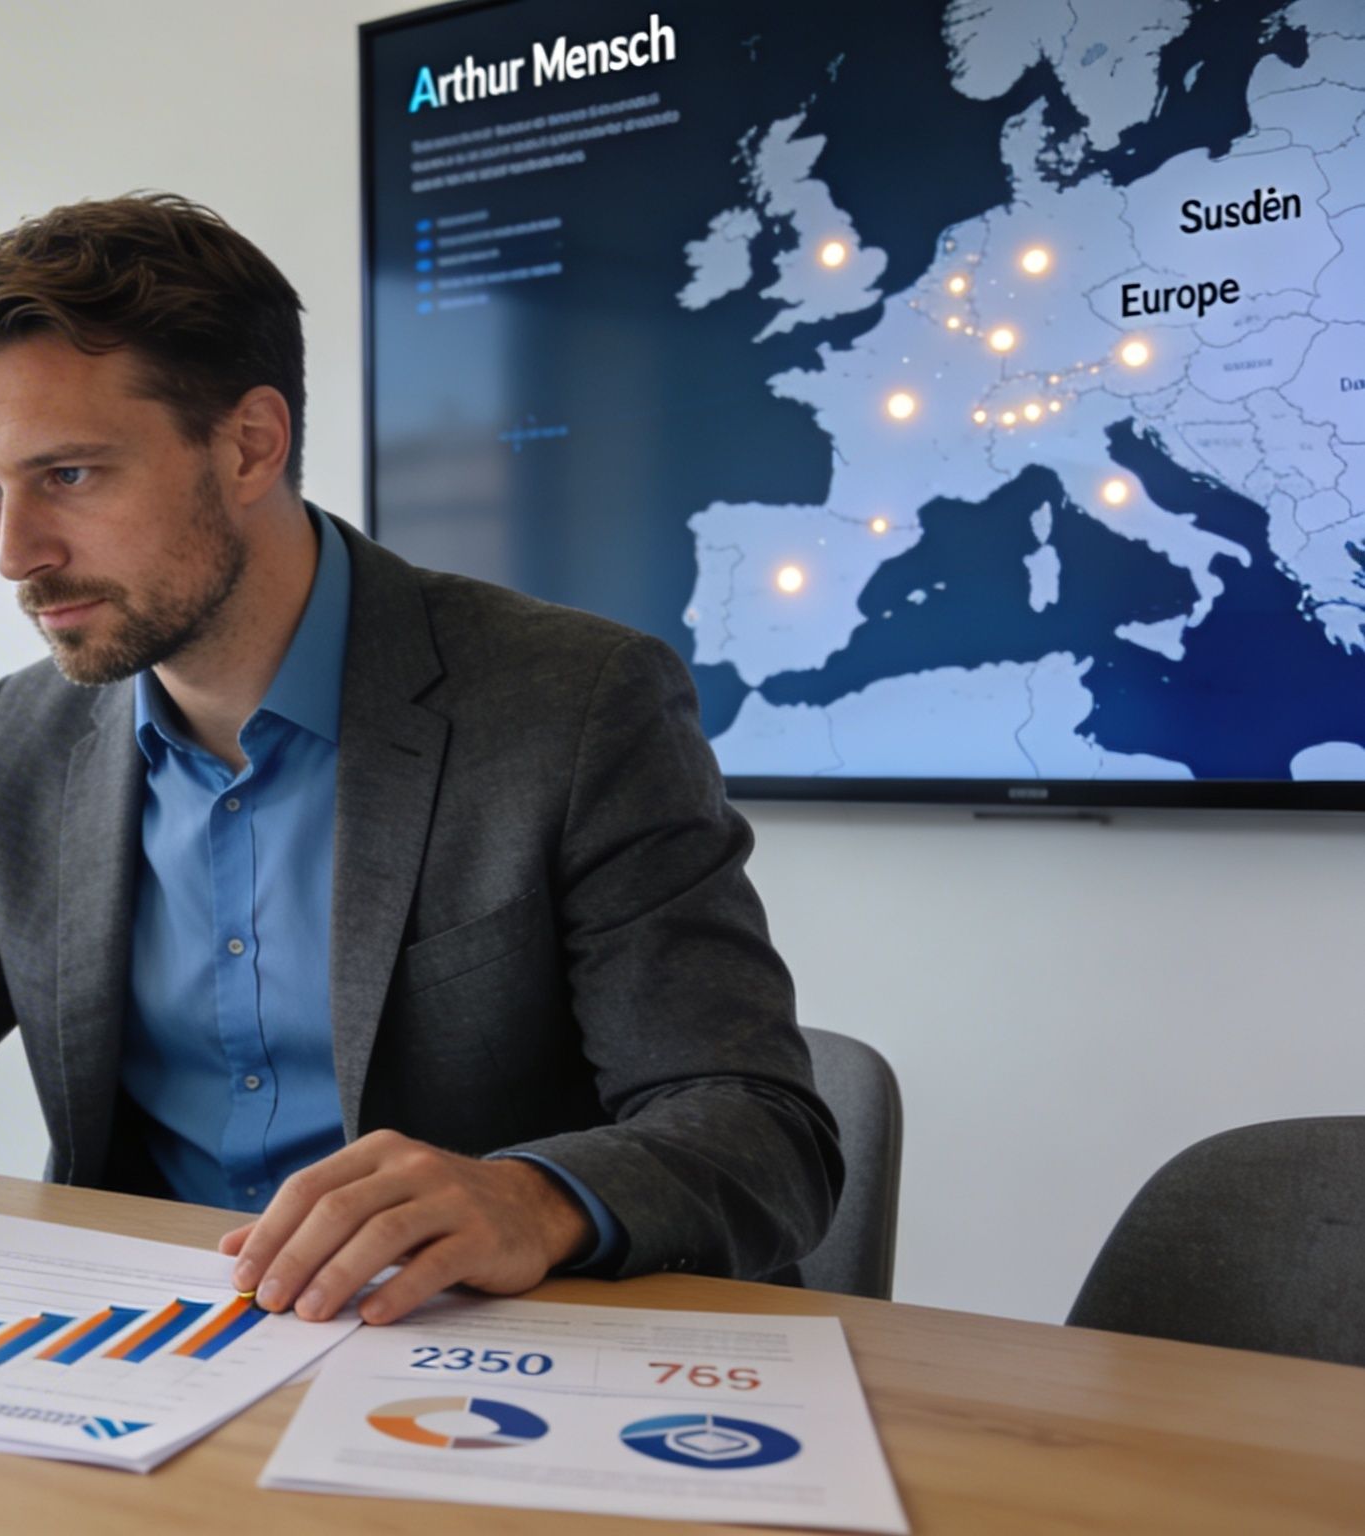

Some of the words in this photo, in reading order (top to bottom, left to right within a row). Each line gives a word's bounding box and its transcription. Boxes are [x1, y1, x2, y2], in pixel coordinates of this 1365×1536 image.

[408, 55, 526, 113] Arthur
[532, 14, 676, 87] Mensch
[1121, 278, 1241, 318] Europe
[409, 1346, 554, 1377] 2350
